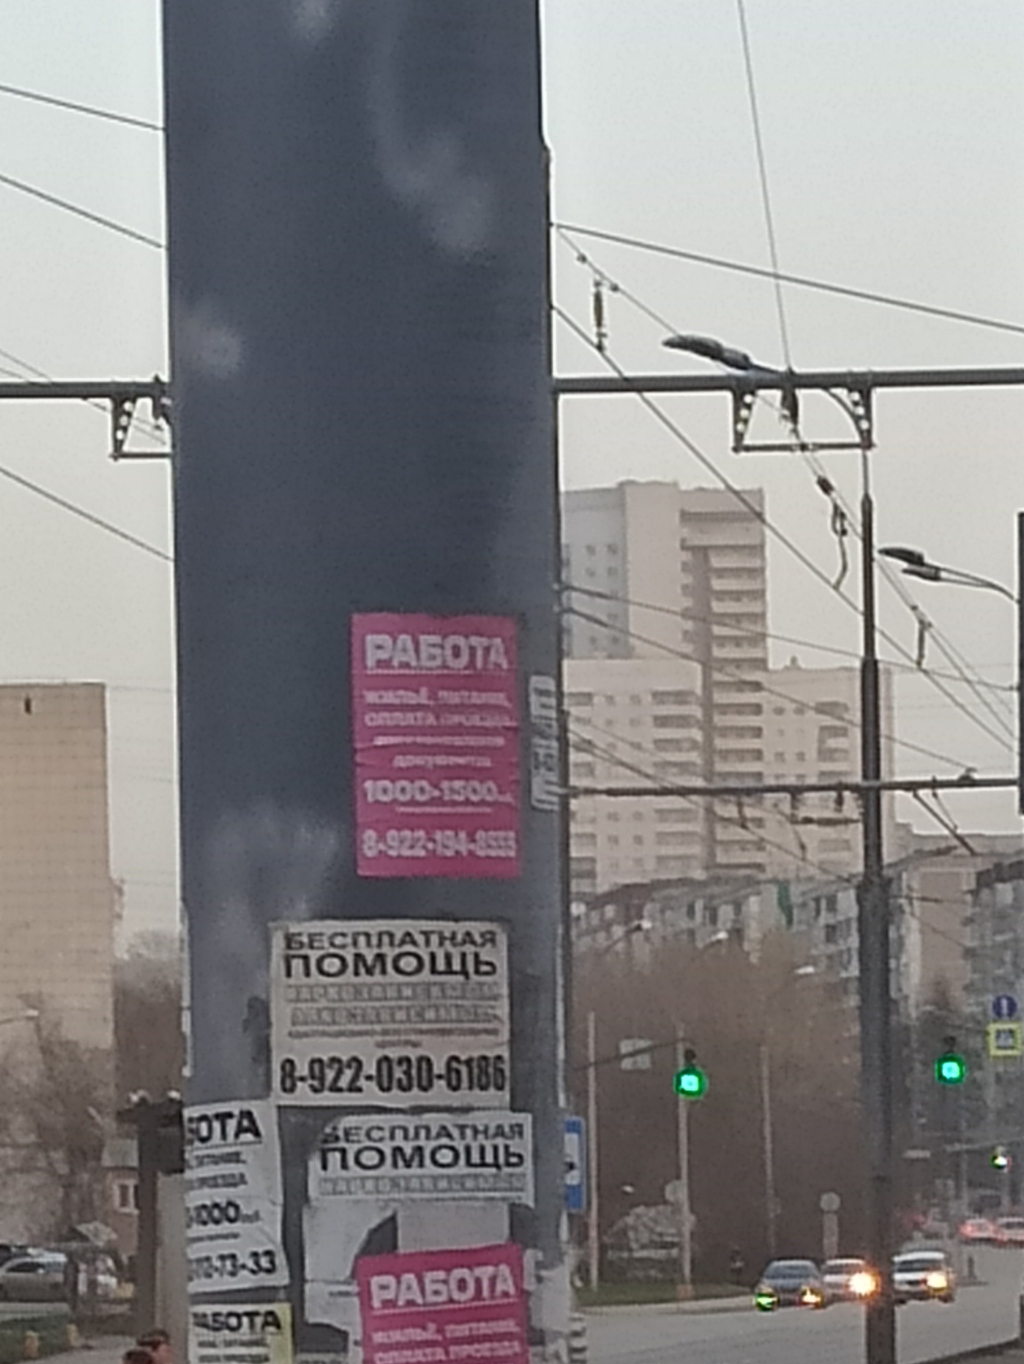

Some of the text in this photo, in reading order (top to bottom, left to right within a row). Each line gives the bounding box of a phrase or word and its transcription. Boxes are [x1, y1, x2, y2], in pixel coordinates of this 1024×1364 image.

[364, 633, 508, 670] РАБОТА
[364, 779, 498, 803] 1000-1500
[284, 930, 498, 951] БЕСПЛАТНАЯ
[284, 950, 498, 980] ПОМОЩЬ
[279, 1054, 506, 1095] 8-922-030-6186
[321, 1122, 526, 1144] БЕСПЛАТНАЯ
[320, 1144, 526, 1171] ПОМОЩЬ
[370, 1262, 516, 1309] РАБОТА
